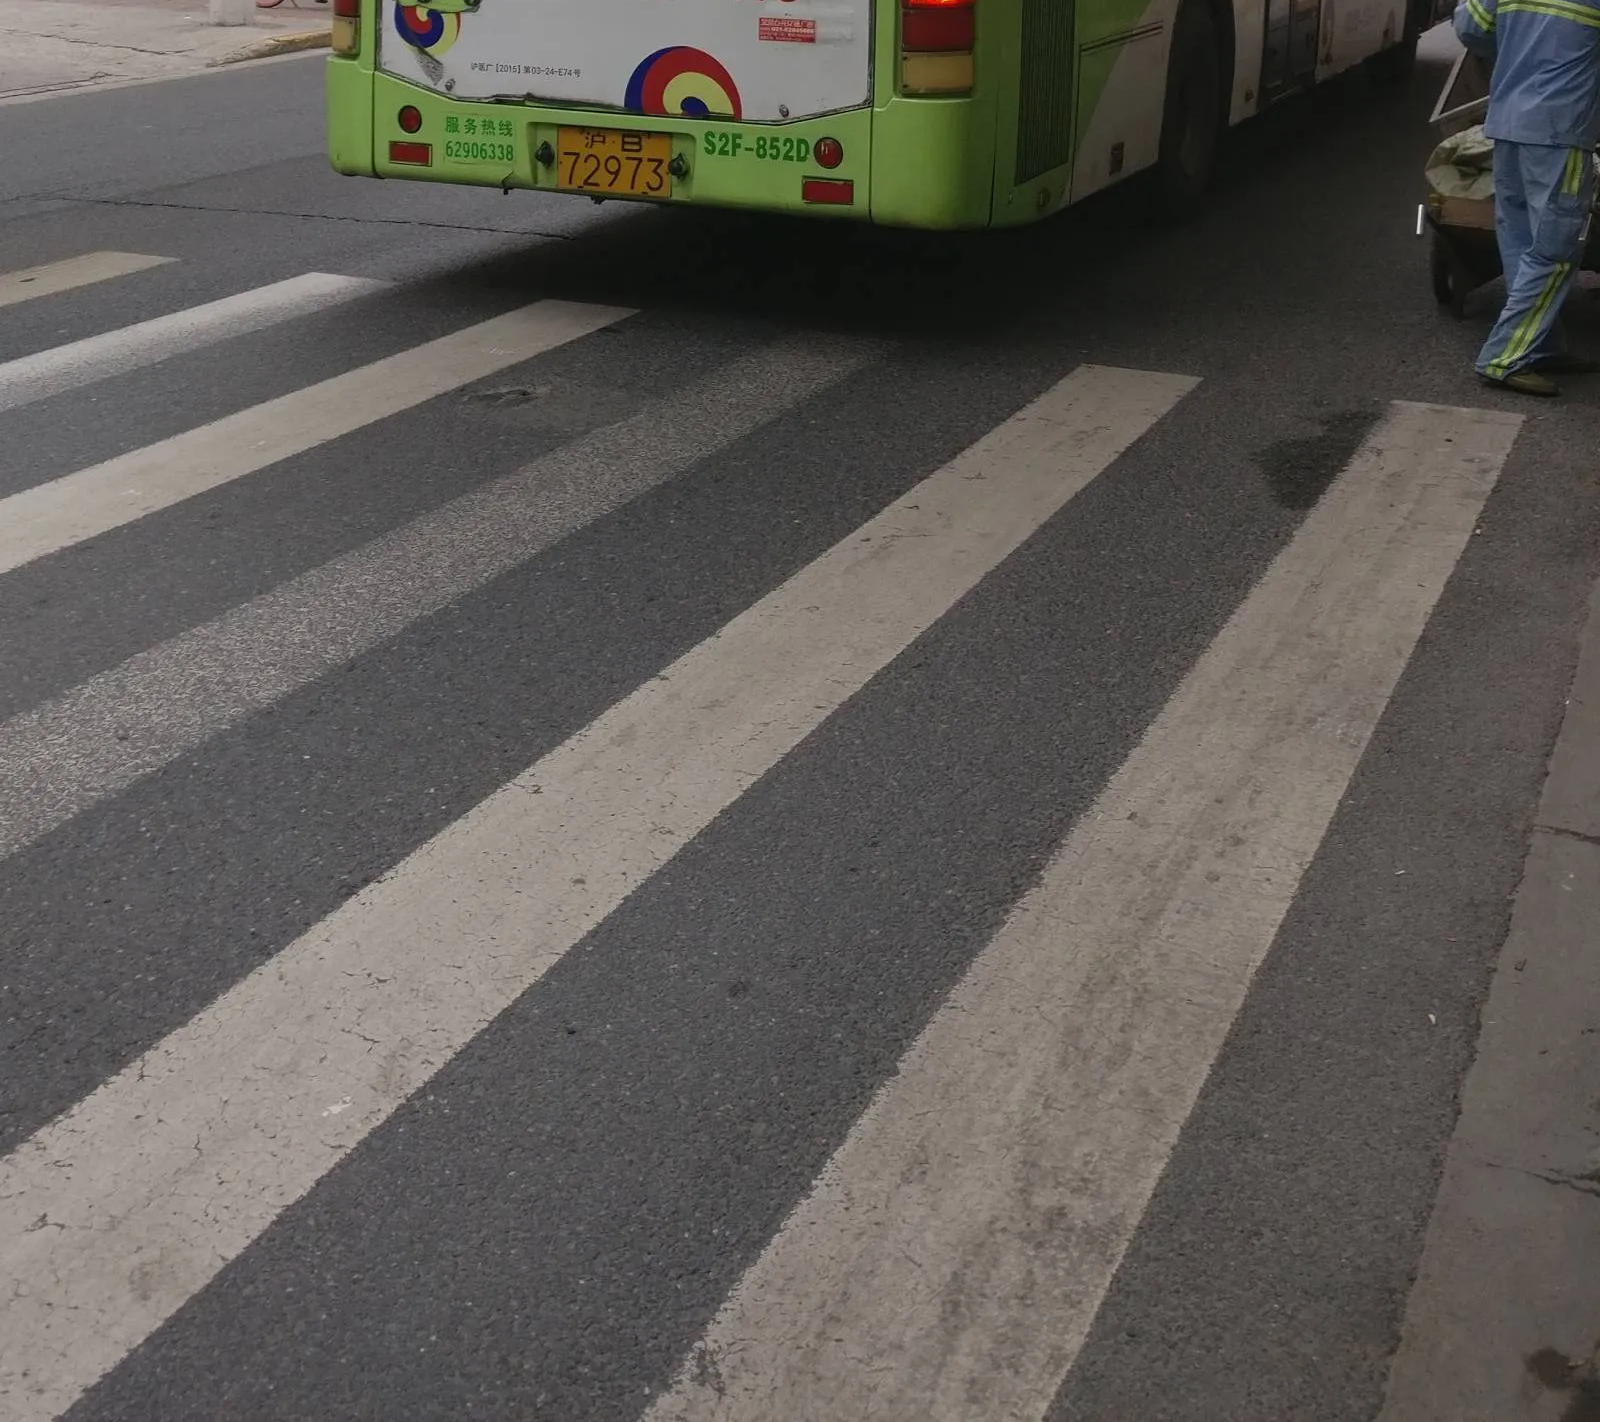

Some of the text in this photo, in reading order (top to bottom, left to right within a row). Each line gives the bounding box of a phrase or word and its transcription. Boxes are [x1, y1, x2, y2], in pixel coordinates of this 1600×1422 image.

[445, 116, 514, 138] 服务热线
[445, 141, 514, 162] 62906338
[703, 130, 810, 162] S2F-852D
[563, 151, 663, 191] 72973
